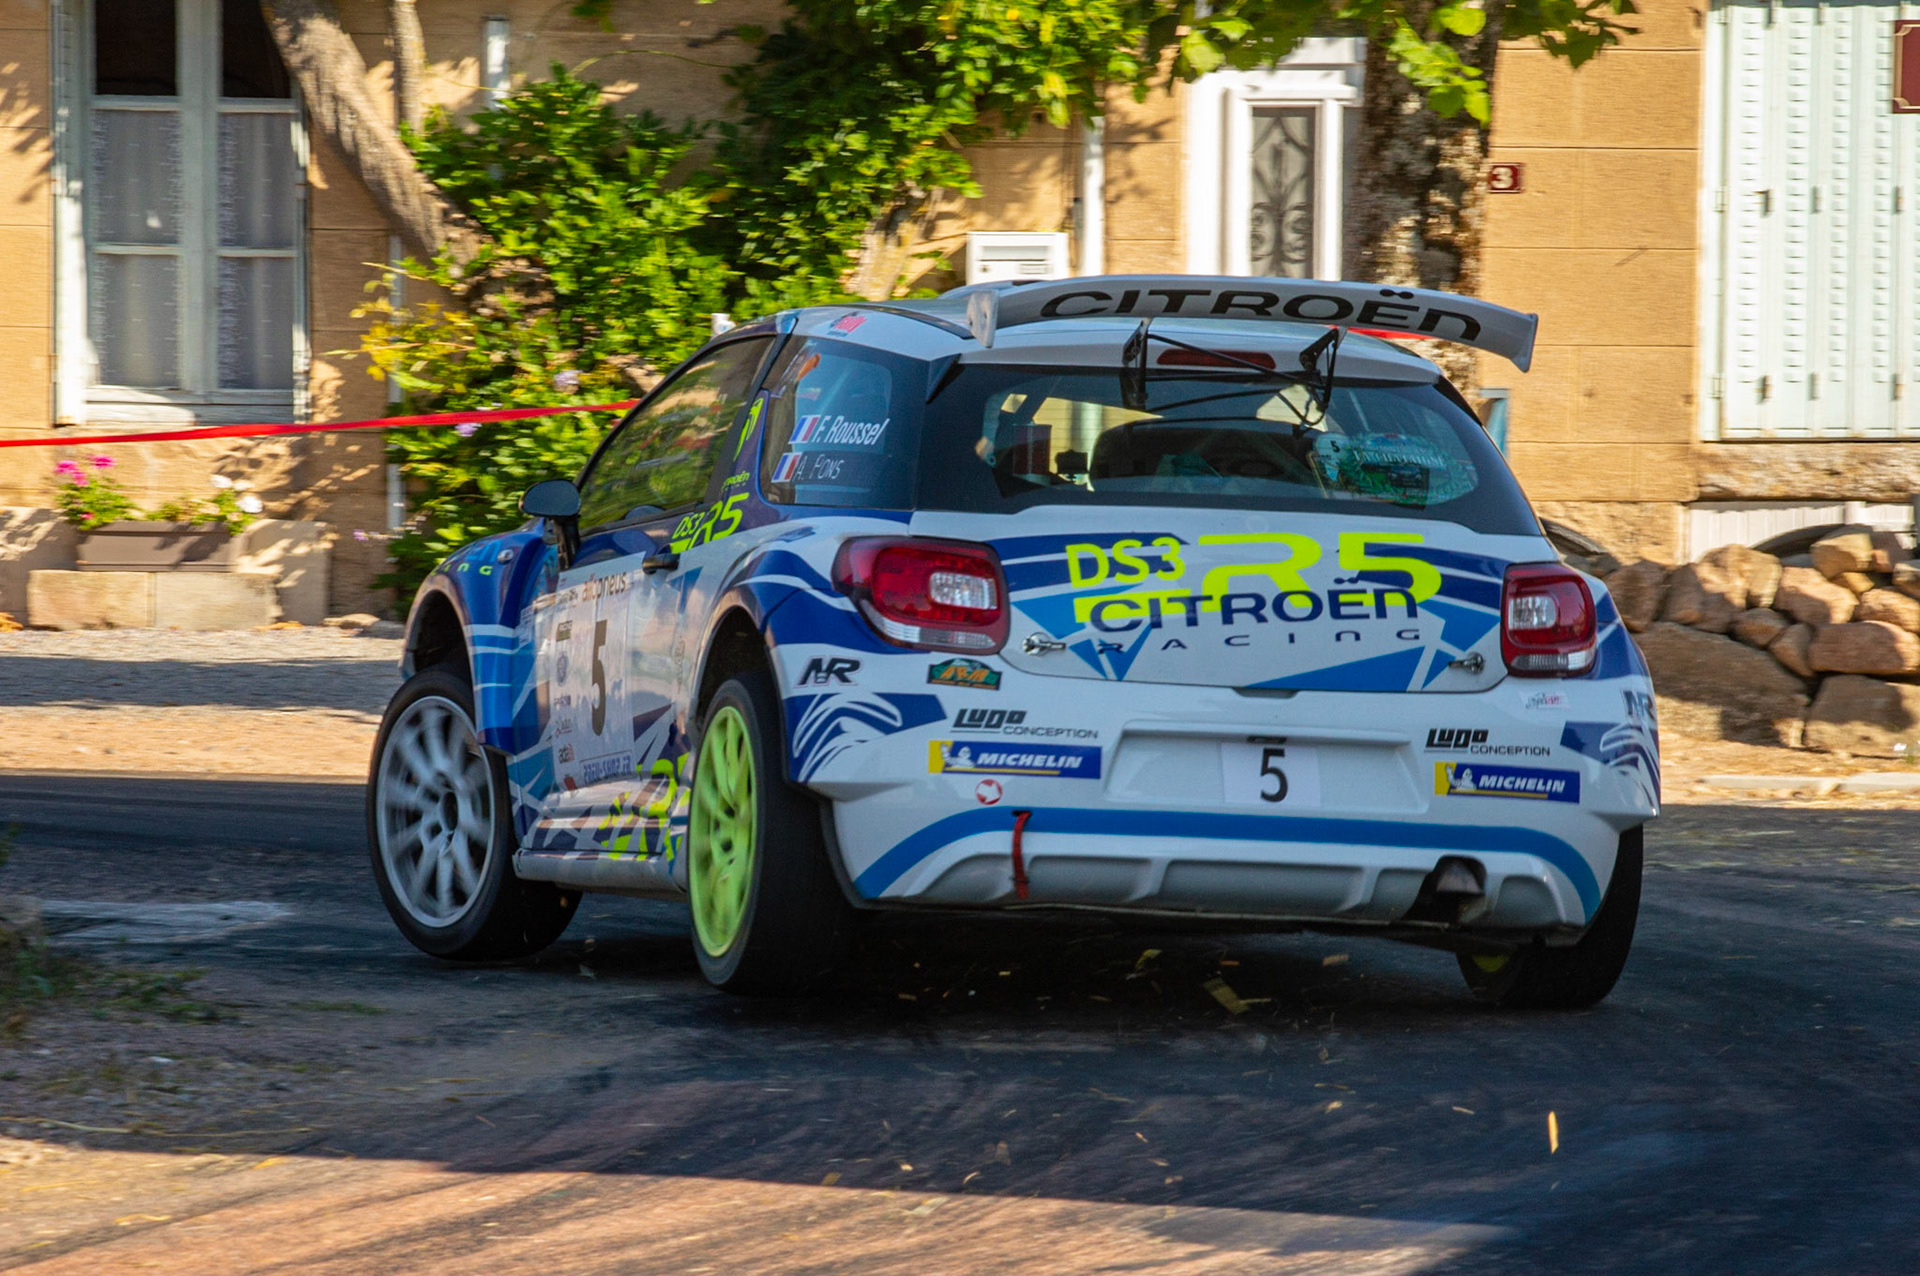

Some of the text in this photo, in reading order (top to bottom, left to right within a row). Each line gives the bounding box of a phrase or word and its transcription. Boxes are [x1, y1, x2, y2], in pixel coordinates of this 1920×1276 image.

[1491, 167, 1513, 189] 3
[1041, 288, 1481, 341] CITROËN
[811, 415, 890, 446] F. Roussel
[1331, 440, 1341, 453] 5
[1065, 532, 1442, 612] DS3 R5
[1089, 575, 1419, 633] CITROËN
[591, 619, 608, 736] 5
[1003, 725, 1099, 739] CONCEPTION
[977, 752, 1083, 769] MICHELIN
[1470, 744, 1551, 756] CONCEPTION
[1260, 748, 1289, 802] 5
[1478, 774, 1566, 794] MICHELIN
